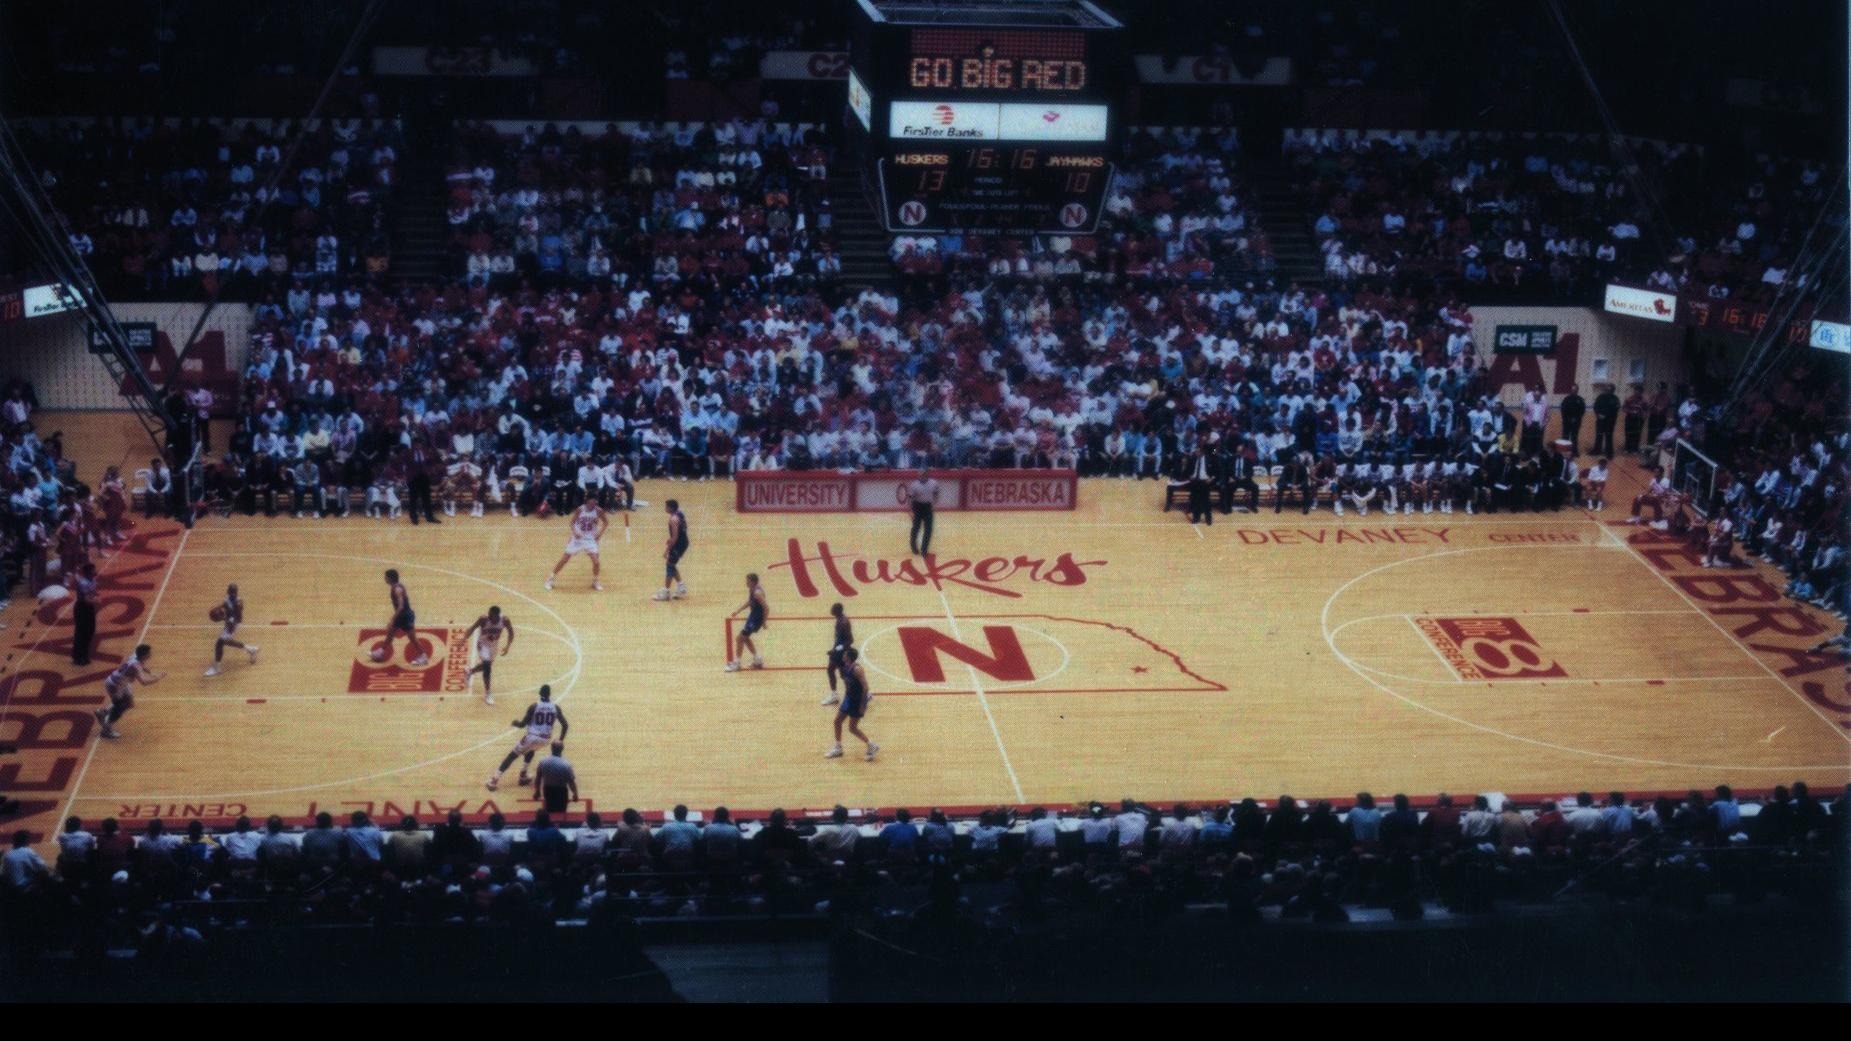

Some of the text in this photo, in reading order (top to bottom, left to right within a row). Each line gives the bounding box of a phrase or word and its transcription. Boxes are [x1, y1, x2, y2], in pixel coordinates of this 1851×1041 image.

[911, 58, 1086, 90] GO BIG RED
[947, 127, 984, 137] Banks
[895, 154, 950, 165] HUSKERS
[1046, 156, 1104, 167] JAYHAWKS
[917, 171, 946, 191] 13
[1065, 172, 1091, 193] 10
[1488, 333, 1580, 395] A1
[749, 482, 847, 508] UNIVERSITY
[970, 481, 1066, 504] NEBRASKA
[1236, 527, 1581, 546] DEVANEY CENTER
[767, 538, 1109, 598] Huskers
[352, 631, 448, 690] BIG 8
[445, 627, 467, 692] CONFERENCE
[897, 625, 1036, 683] N
[1415, 618, 1484, 680] CONFERENCE
[1460, 636, 1555, 675] 8
[534, 711, 555, 726] 00
[118, 802, 248, 818] CENTER
